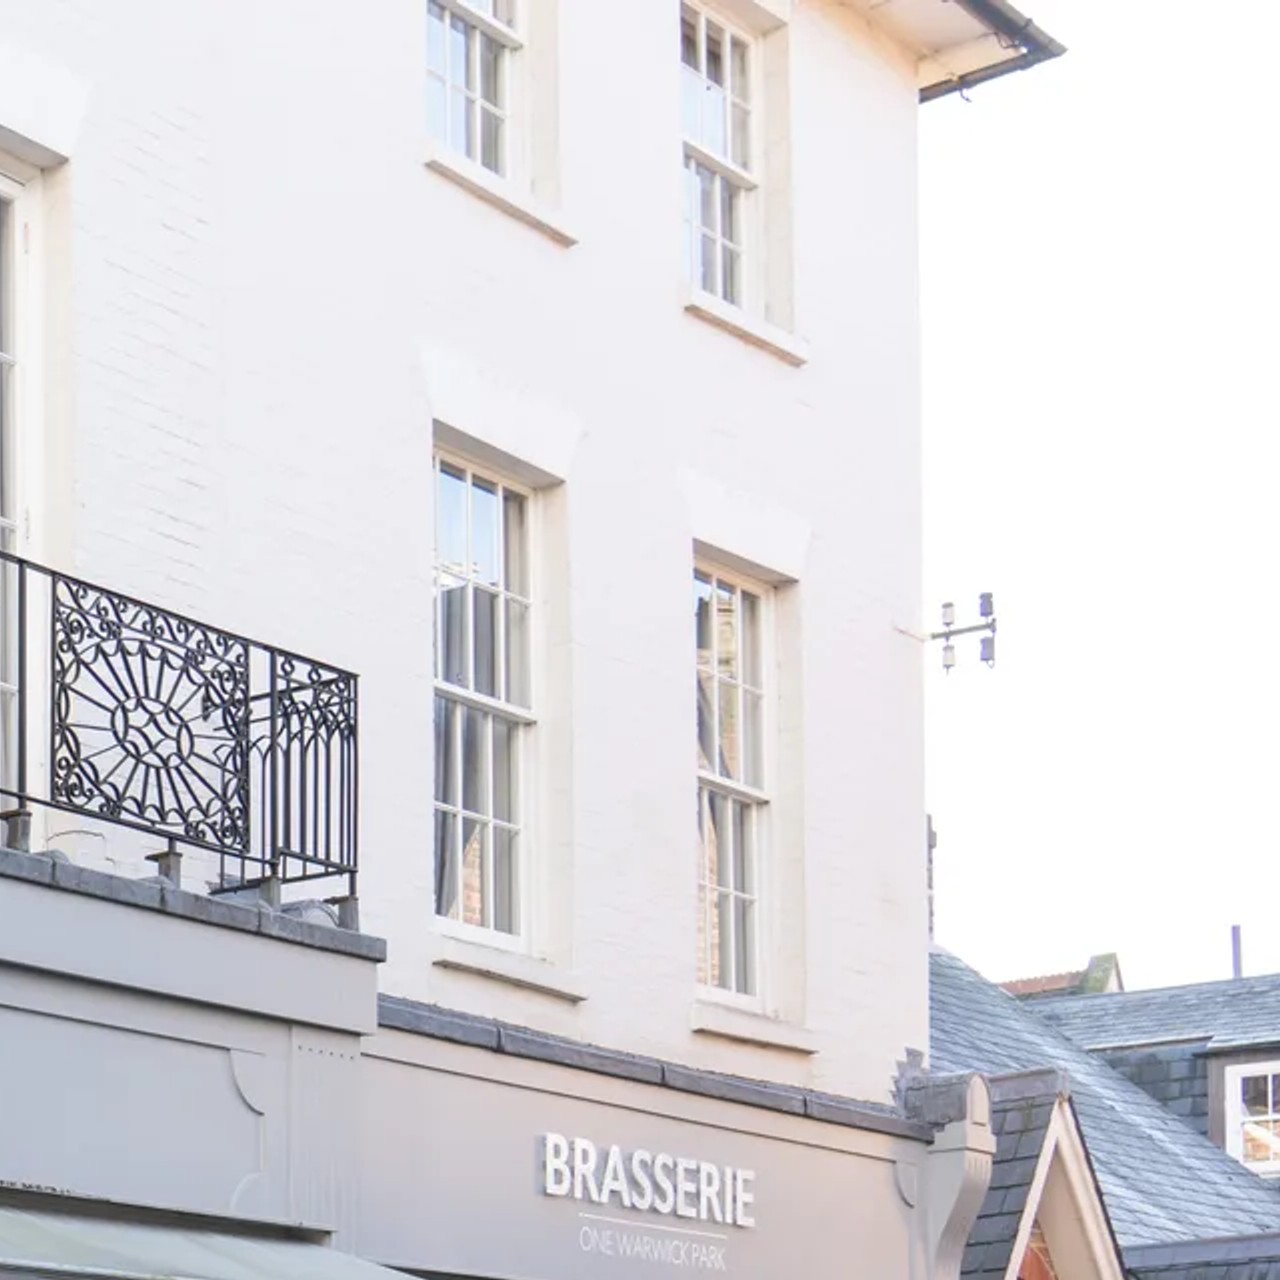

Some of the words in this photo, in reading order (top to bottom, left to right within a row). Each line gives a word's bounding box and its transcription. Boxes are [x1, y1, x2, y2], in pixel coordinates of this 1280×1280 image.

[544, 1131, 756, 1228] BRASSERIE
[578, 1226, 614, 1255] ONE
[616, 1231, 689, 1266] WARWICK
[691, 1243, 727, 1271] PARK
